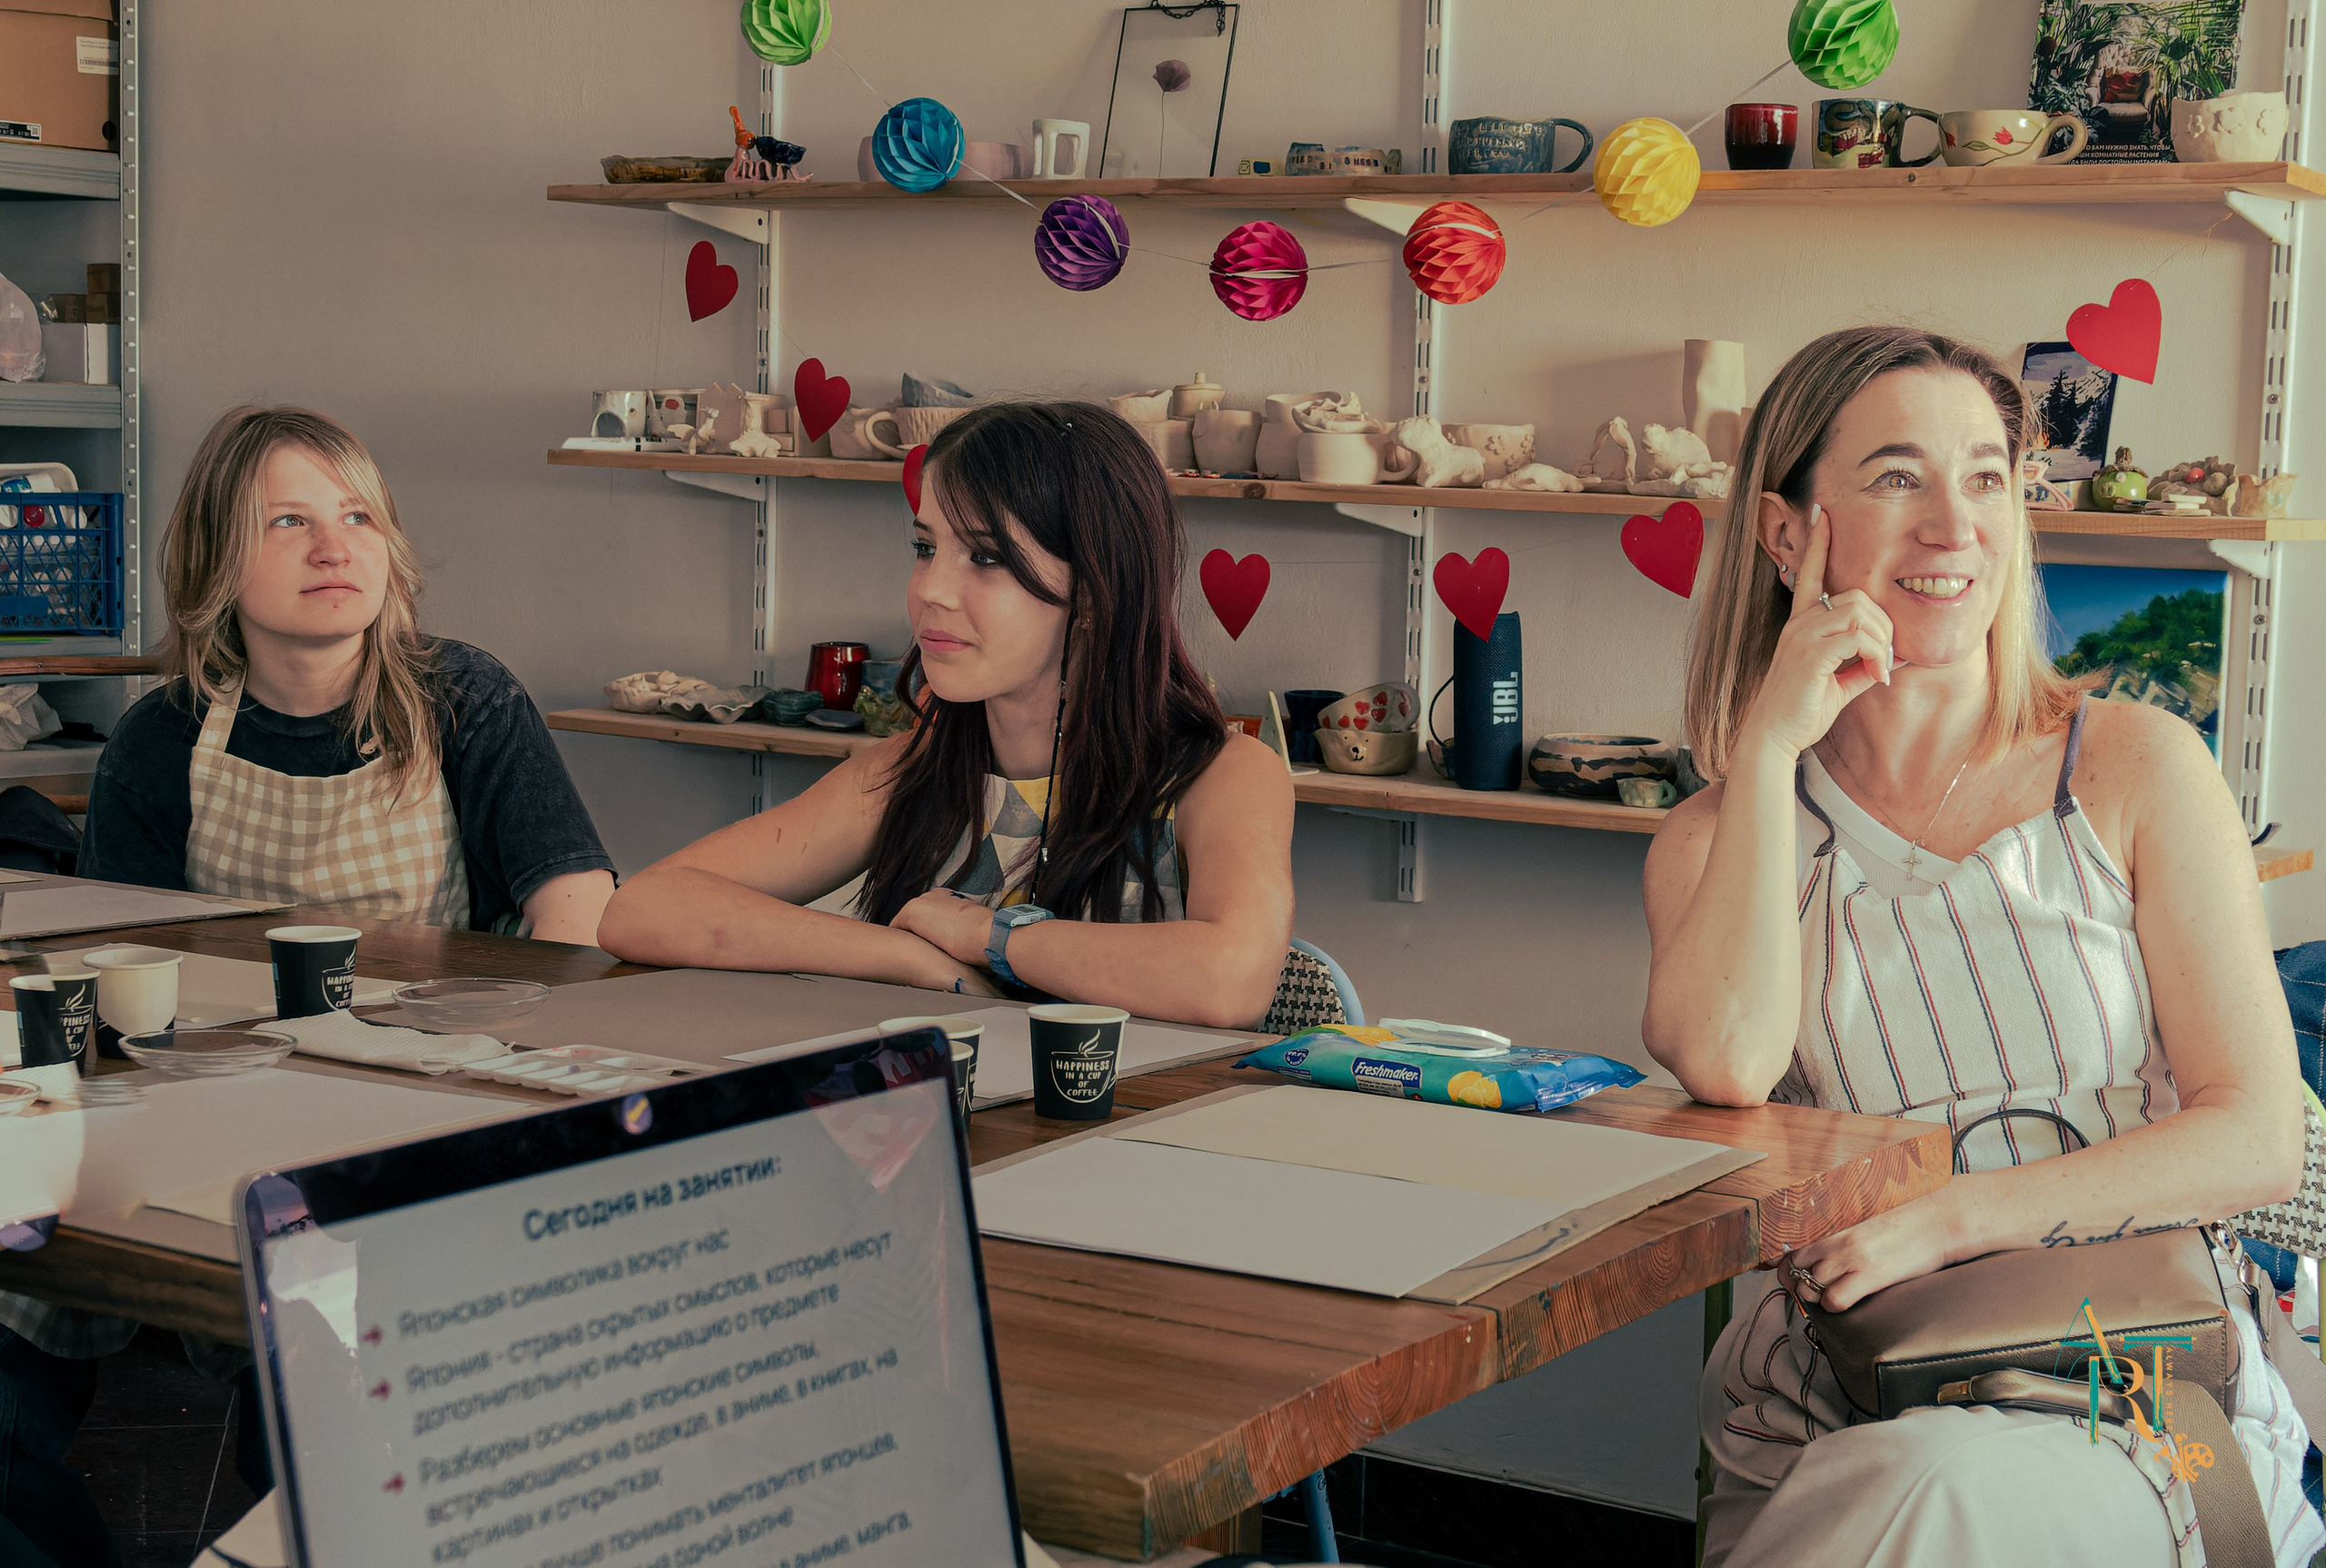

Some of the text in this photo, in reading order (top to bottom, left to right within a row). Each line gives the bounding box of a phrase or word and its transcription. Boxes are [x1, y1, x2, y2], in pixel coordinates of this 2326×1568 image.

[1493, 671, 1518, 723] JBL
[1056, 1059, 1110, 1072] HAPPINESS
[1355, 1061, 1417, 1081] Freshmaker
[1079, 1072, 1084, 1080] A
[1067, 1088, 1098, 1097] COFFEE
[522, 1155, 782, 1241] Сегодня на занятии:
[736, 1313, 748, 1333] о
[603, 1438, 631, 1462] на
[876, 1347, 900, 1369] на
